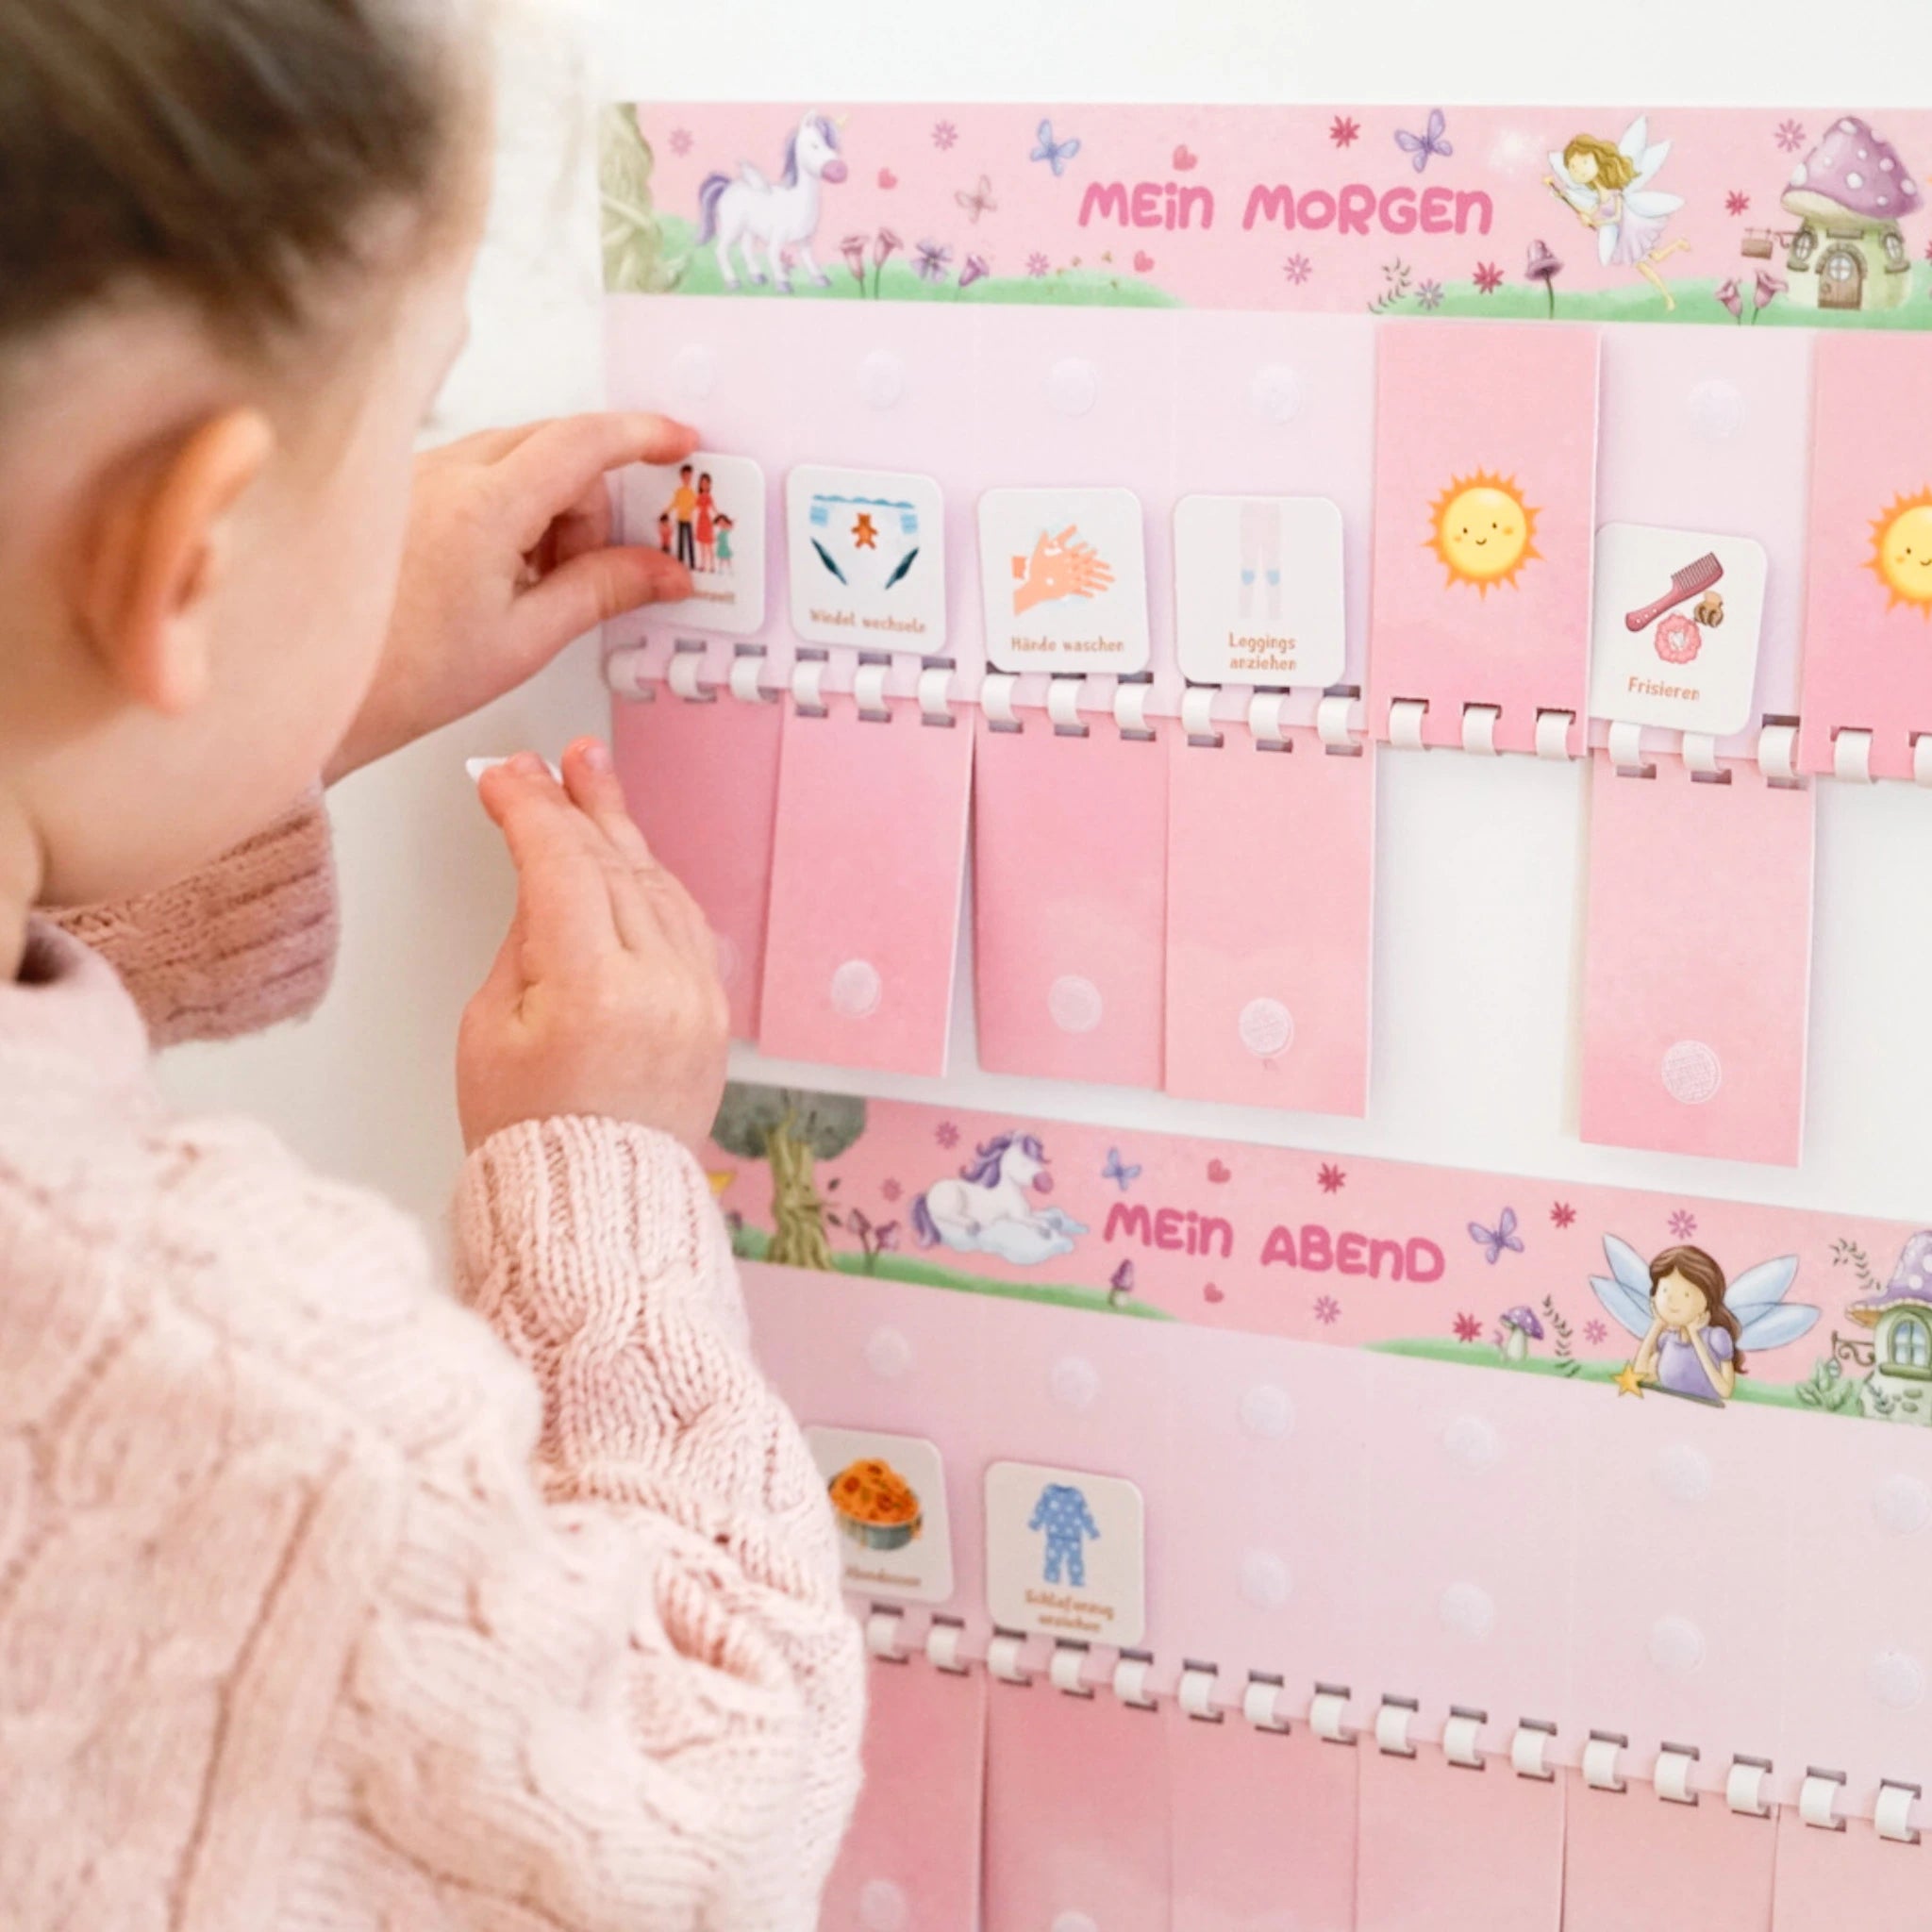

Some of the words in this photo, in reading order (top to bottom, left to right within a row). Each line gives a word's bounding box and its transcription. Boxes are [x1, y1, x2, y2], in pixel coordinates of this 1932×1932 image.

[1010, 635, 1057, 652] Hände
[1062, 635, 1124, 652] waschen
[1228, 631, 1297, 654] Leggings
[1229, 654, 1298, 671] anziehen
[1627, 675, 1701, 701] Frisieren
